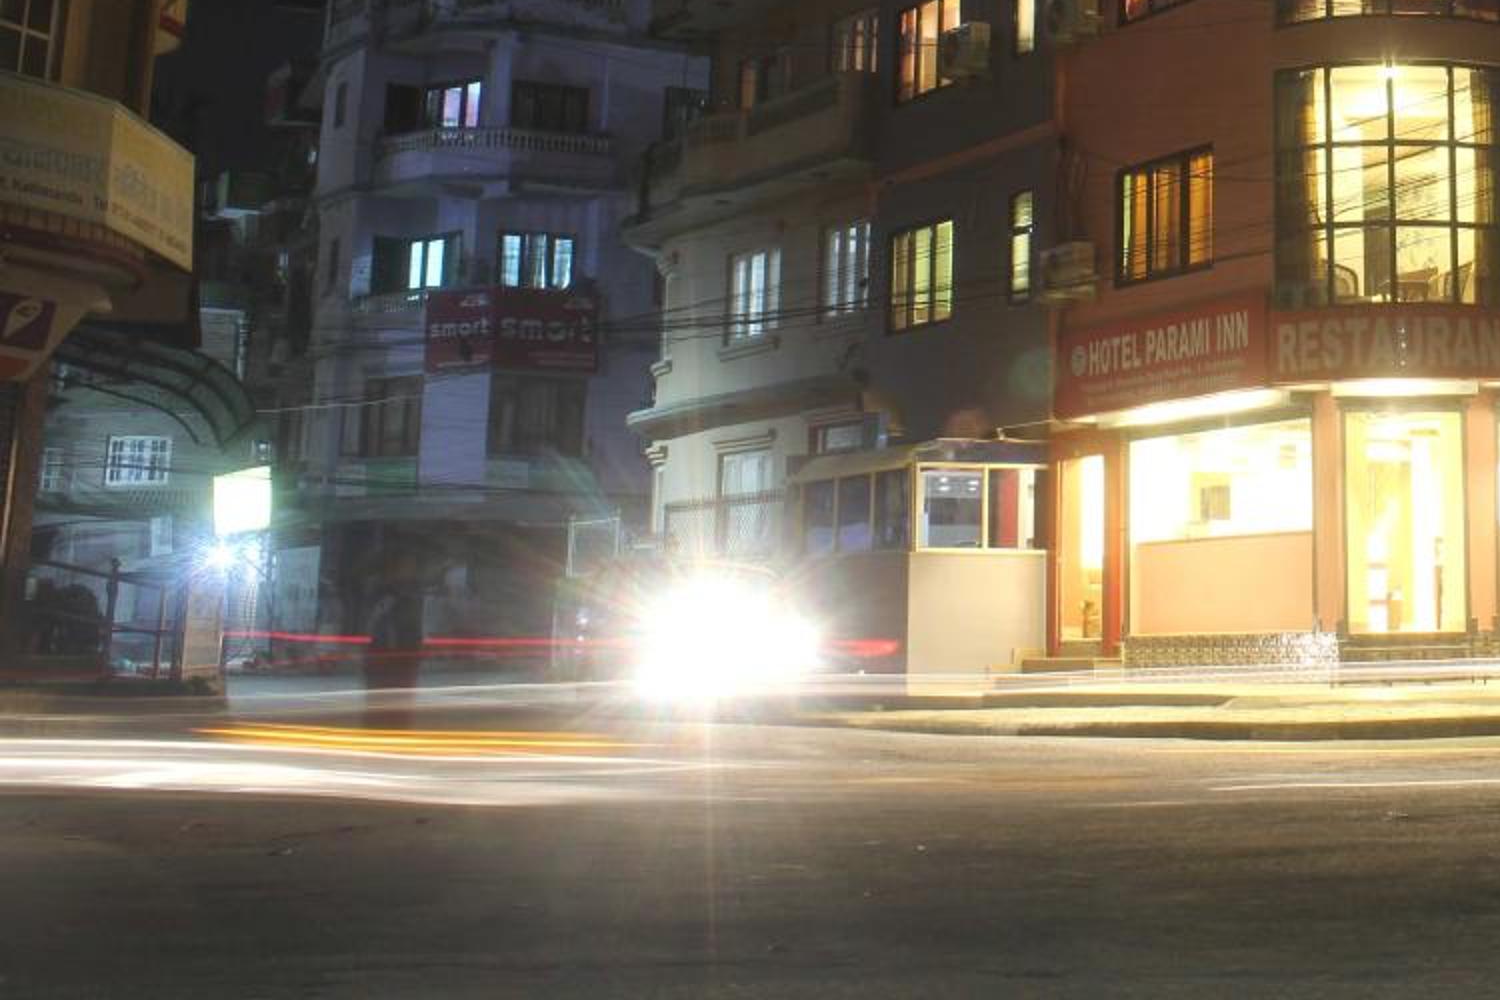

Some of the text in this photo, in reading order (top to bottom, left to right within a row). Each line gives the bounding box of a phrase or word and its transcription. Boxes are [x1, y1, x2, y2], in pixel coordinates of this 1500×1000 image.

[1088, 311, 1249, 376] HOTEL PARAMI INN
